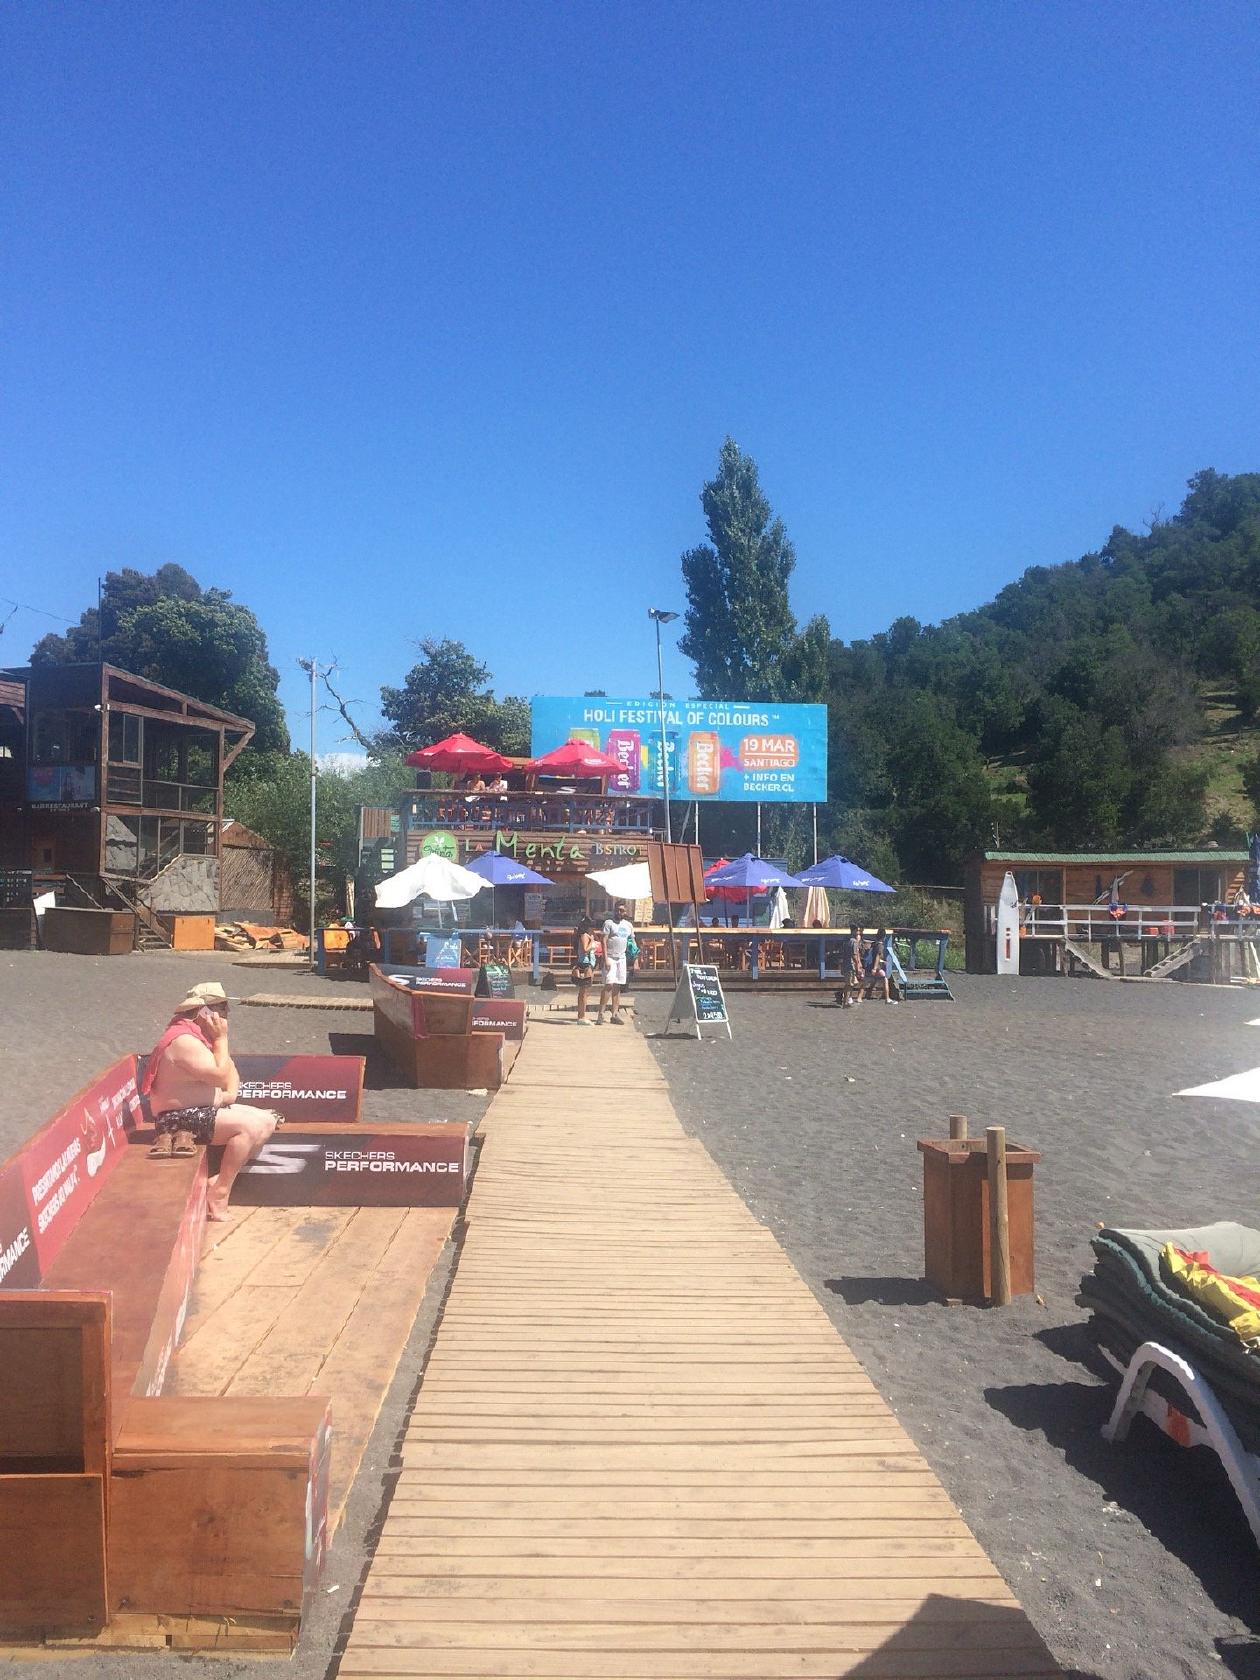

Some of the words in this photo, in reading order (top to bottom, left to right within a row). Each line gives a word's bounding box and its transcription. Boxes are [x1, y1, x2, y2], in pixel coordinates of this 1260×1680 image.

[584, 709, 615, 722] HOLI
[620, 710, 683, 725] FESTIVAL
[687, 711, 705, 725] OF
[708, 712, 769, 727] COLOURS
[743, 738, 759, 752] 19
[762, 738, 795, 753] MAR
[696, 742, 714, 791] Becker
[743, 758, 796, 767] SANTIAGO
[752, 773, 778, 781] INFO
[780, 774, 795, 782] EN
[743, 783, 795, 792] BECKER.CL
[465, 839, 484, 852] LA
[495, 830, 586, 861] Menta
[237, 1089, 347, 1100] PERFORMANCE
[325, 1151, 396, 1161] SKECHERS
[324, 1160, 460, 1173] PERFORMANCE
